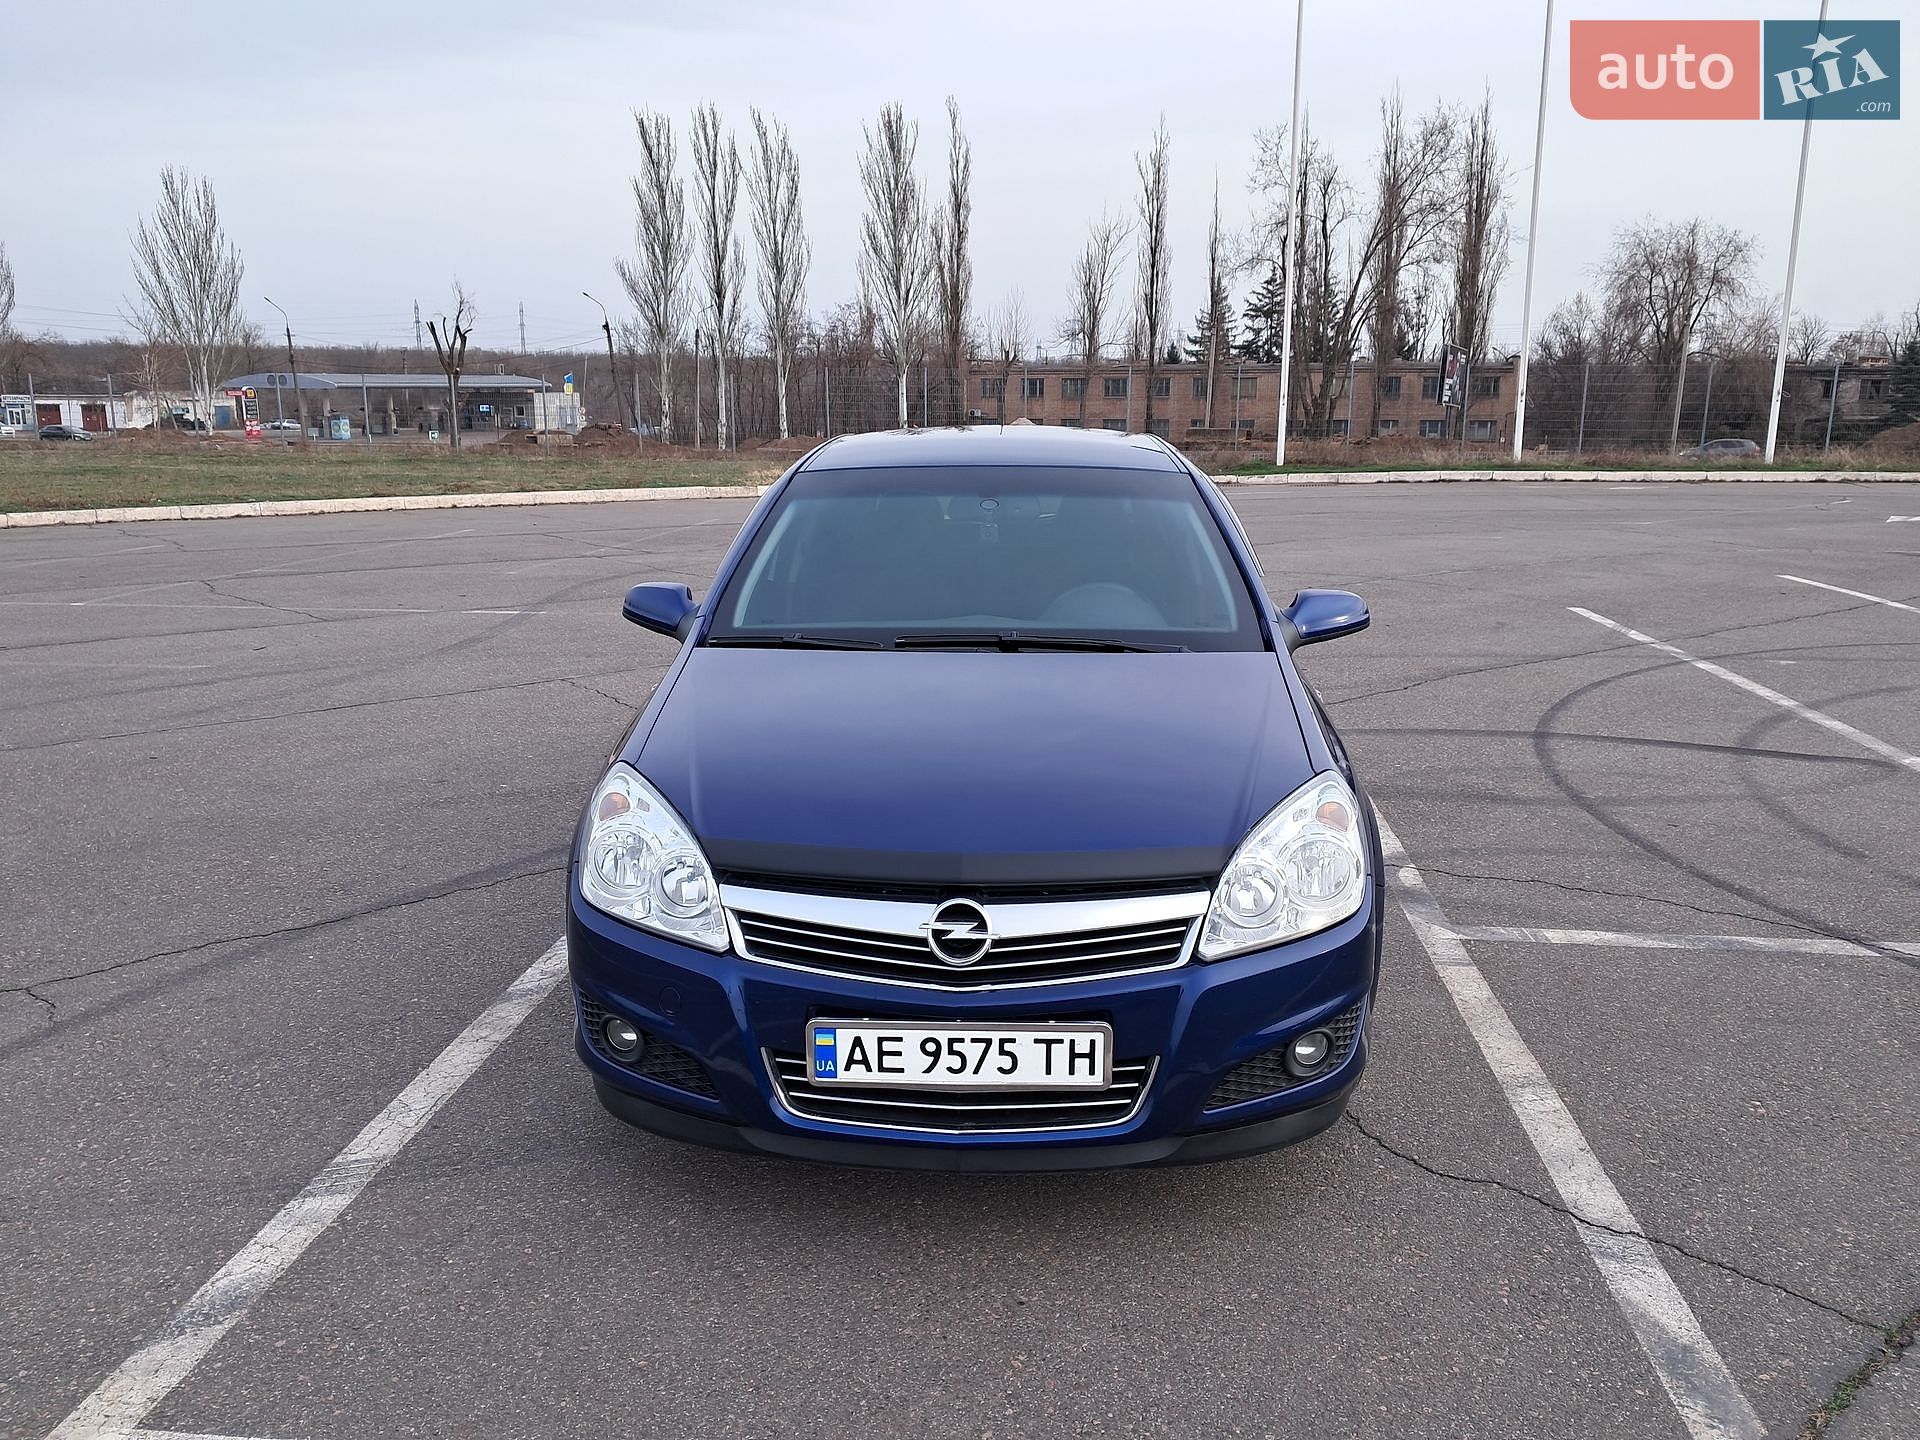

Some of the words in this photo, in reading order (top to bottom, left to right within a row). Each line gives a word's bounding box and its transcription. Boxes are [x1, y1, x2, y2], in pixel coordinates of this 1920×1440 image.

[815, 1060, 835, 1072] UA
[843, 1036, 905, 1073] AE
[919, 1037, 1019, 1075] 9575
[1033, 1038, 1096, 1076] TH
